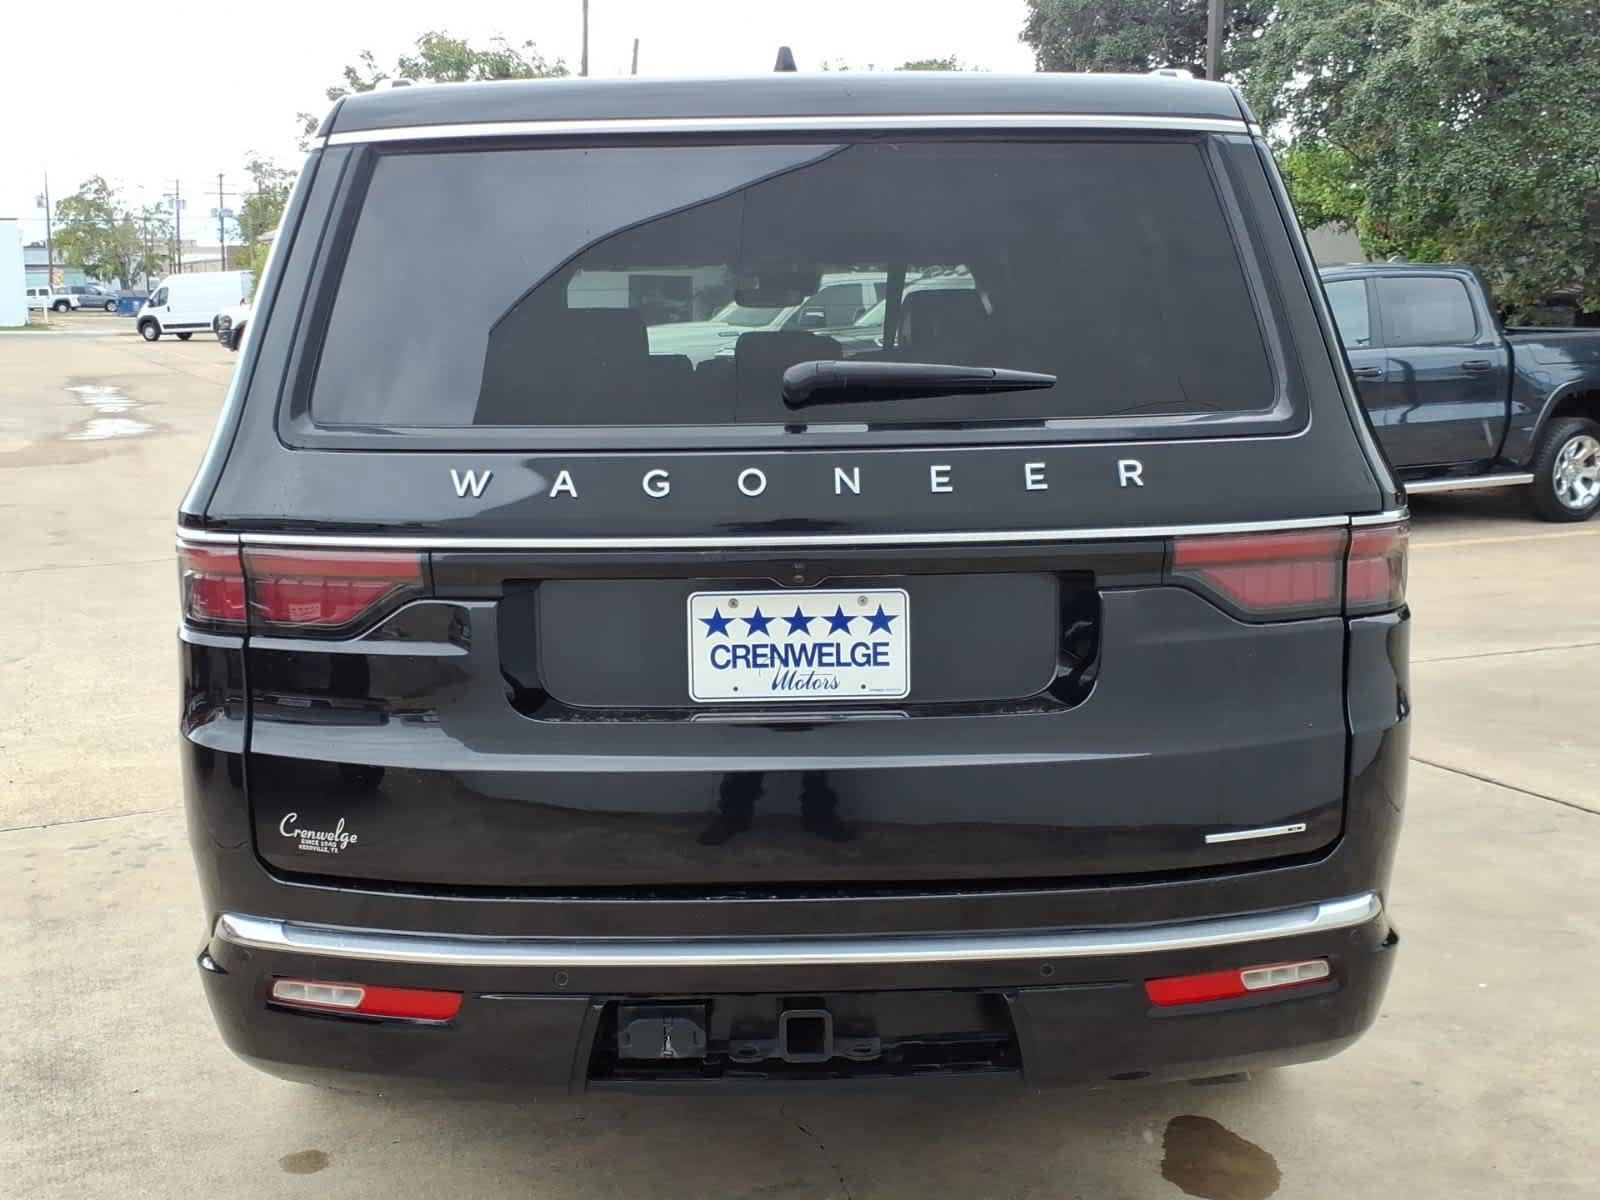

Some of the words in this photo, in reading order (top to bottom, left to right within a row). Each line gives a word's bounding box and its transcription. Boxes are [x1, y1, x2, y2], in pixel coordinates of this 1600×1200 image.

[451, 459, 1146, 499] WAGONEER
[710, 641, 890, 670] CRENWELGE
[771, 666, 840, 691] Motors
[279, 812, 358, 849] Crenwelge
